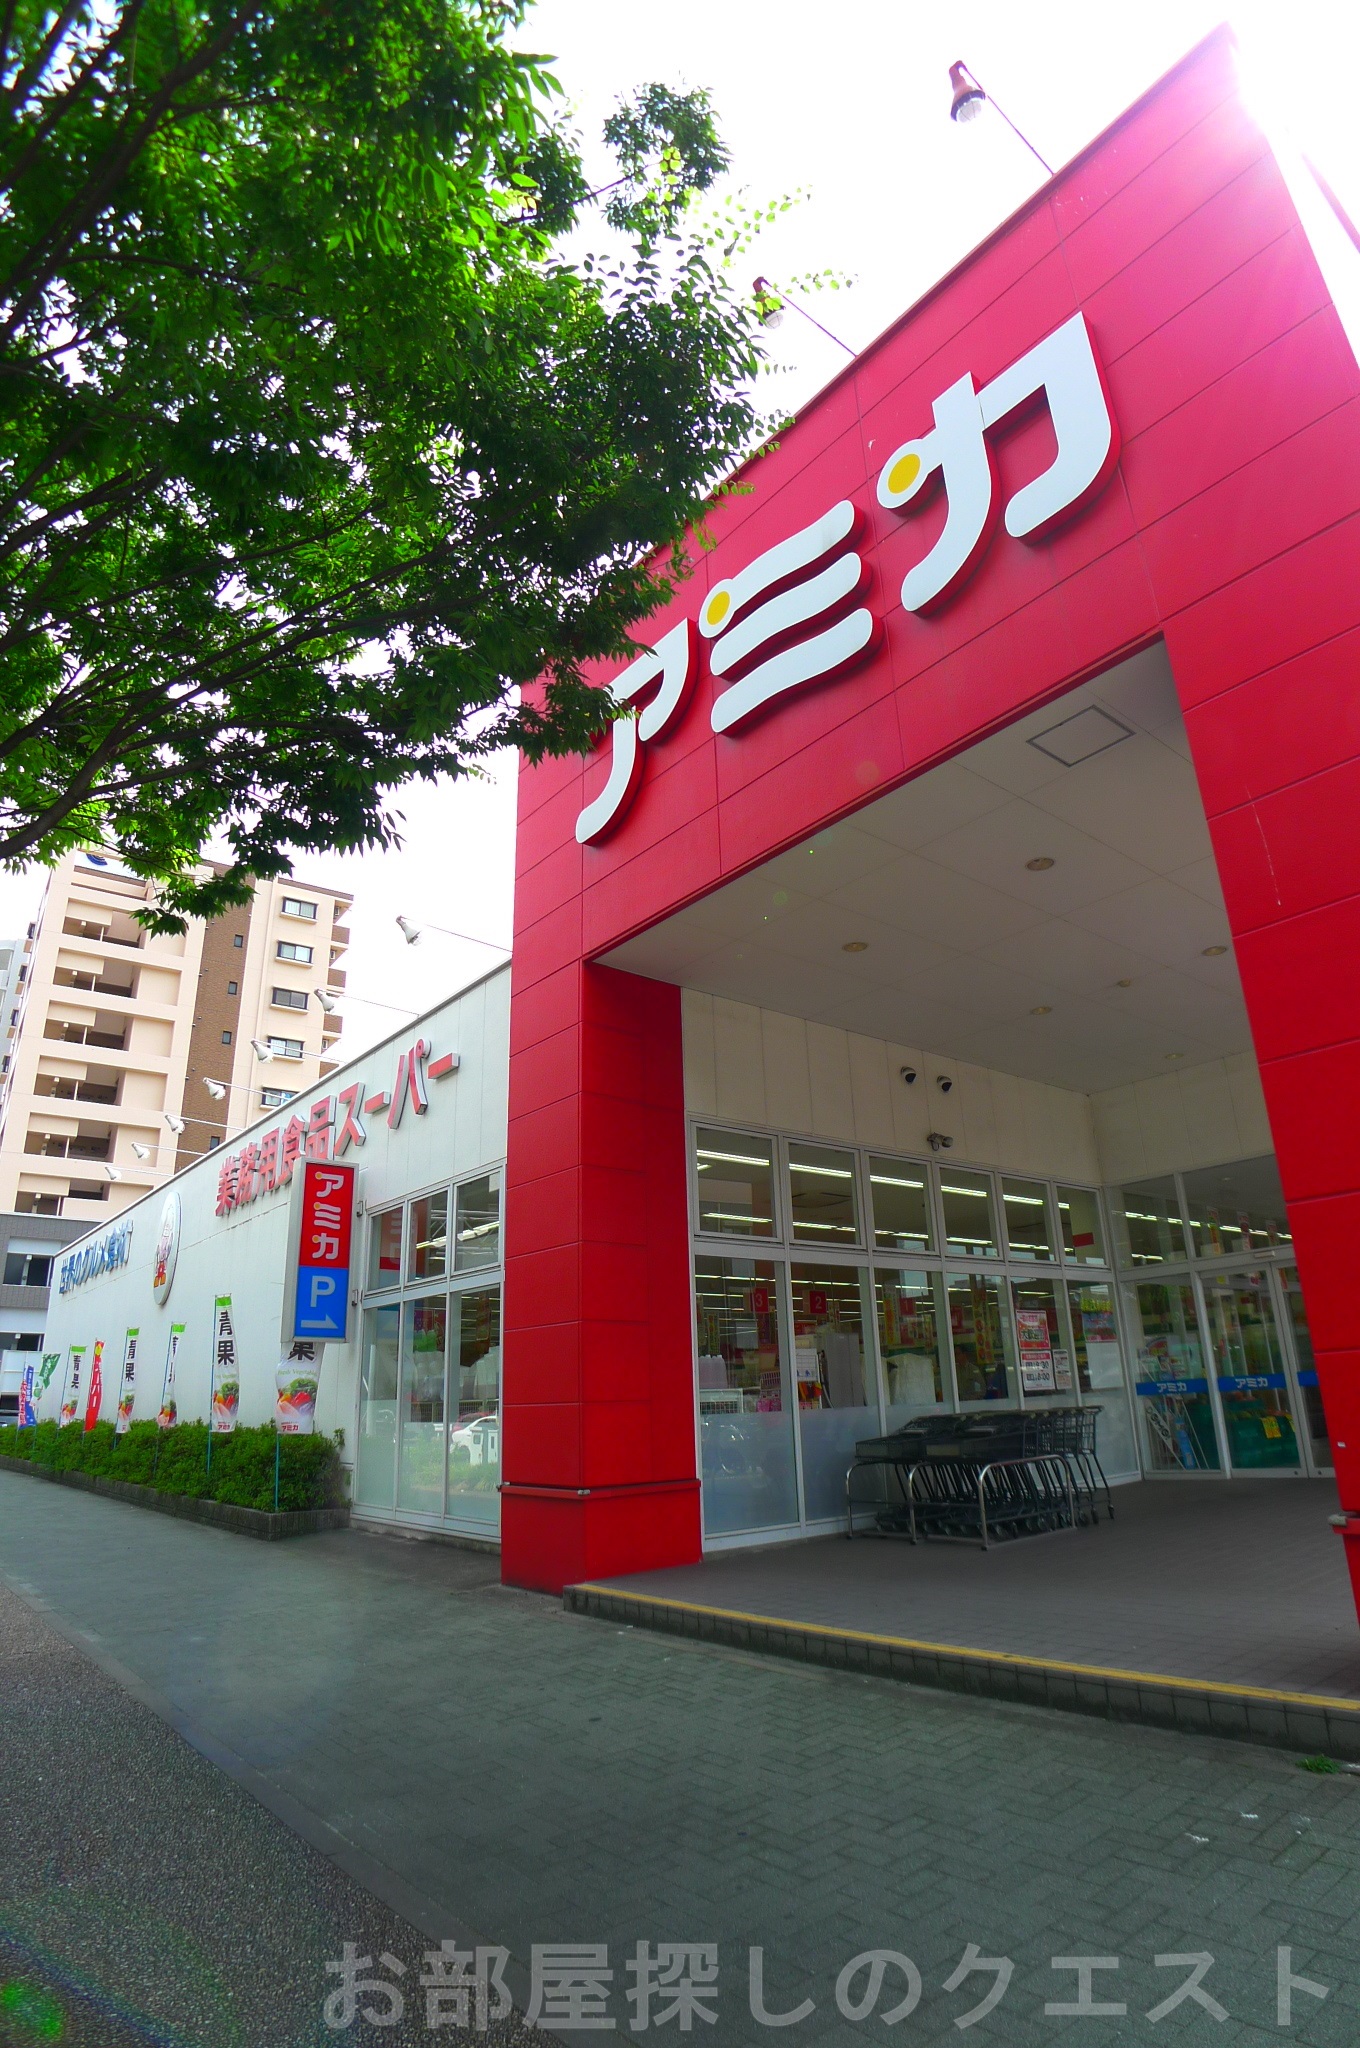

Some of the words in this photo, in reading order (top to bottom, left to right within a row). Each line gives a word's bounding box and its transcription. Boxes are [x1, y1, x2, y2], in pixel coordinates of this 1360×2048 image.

[575, 310, 1112, 844] アミカ
[215, 1038, 460, 1217] 業務用食品スーパー
[312, 1171, 345, 1260] アミカ
[310, 1275, 336, 1308] P
[815, 1296, 823, 1309] 2
[217, 1310, 236, 1366] 青果
[125, 1339, 137, 1382] 青果
[1156, 1382, 1187, 1393] アミカ
[1234, 1377, 1269, 1389] アミカ
